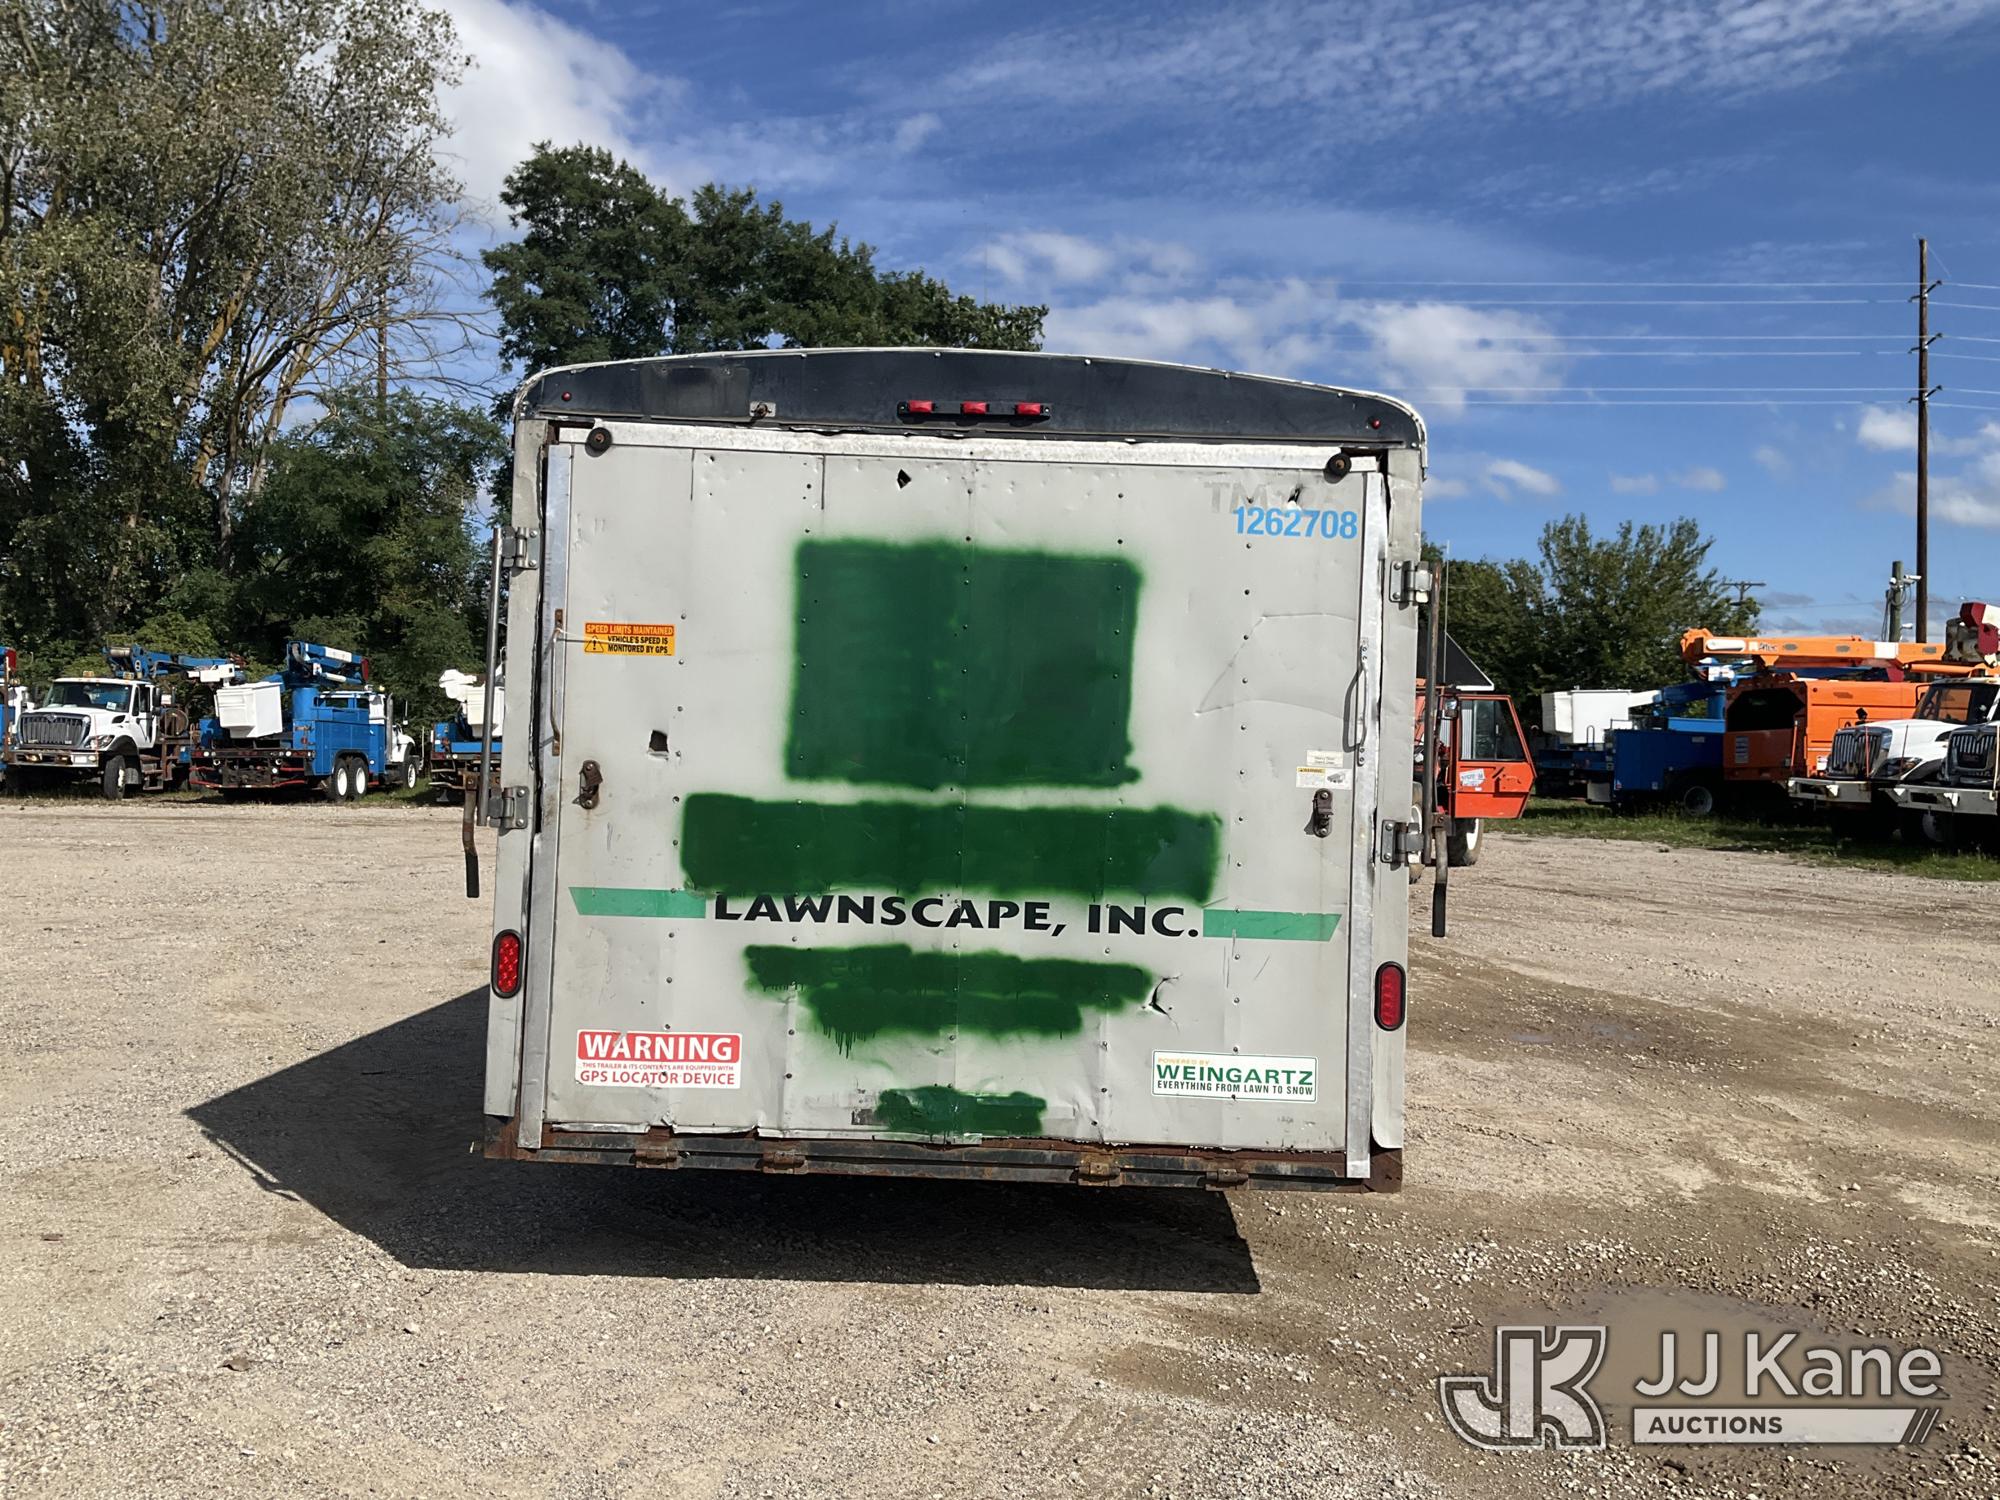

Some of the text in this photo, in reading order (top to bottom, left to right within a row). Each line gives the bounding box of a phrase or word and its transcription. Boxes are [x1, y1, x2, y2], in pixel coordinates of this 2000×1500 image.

[1232, 506, 1358, 540] 1262708
[586, 624, 673, 636] SPEED LIMITS MAINTAINED
[608, 635, 668, 645] VEHICLE'S SPEED IS
[608, 644, 668, 654] MONITORED BY GPS
[714, 894, 1199, 938] LAWNSCAPE, INC.
[584, 1034, 732, 1061] WARNING
[597, 1062, 622, 1070] TRAILER
[638, 1063, 671, 1071] CONTENTS
[580, 1070, 735, 1085] GPS LOCATOR DEVICE
[1157, 1064, 1313, 1086] WEINGARTZ
[1157, 1080, 1313, 1096] EVERYTHING FROM LAWN TO SNOW
